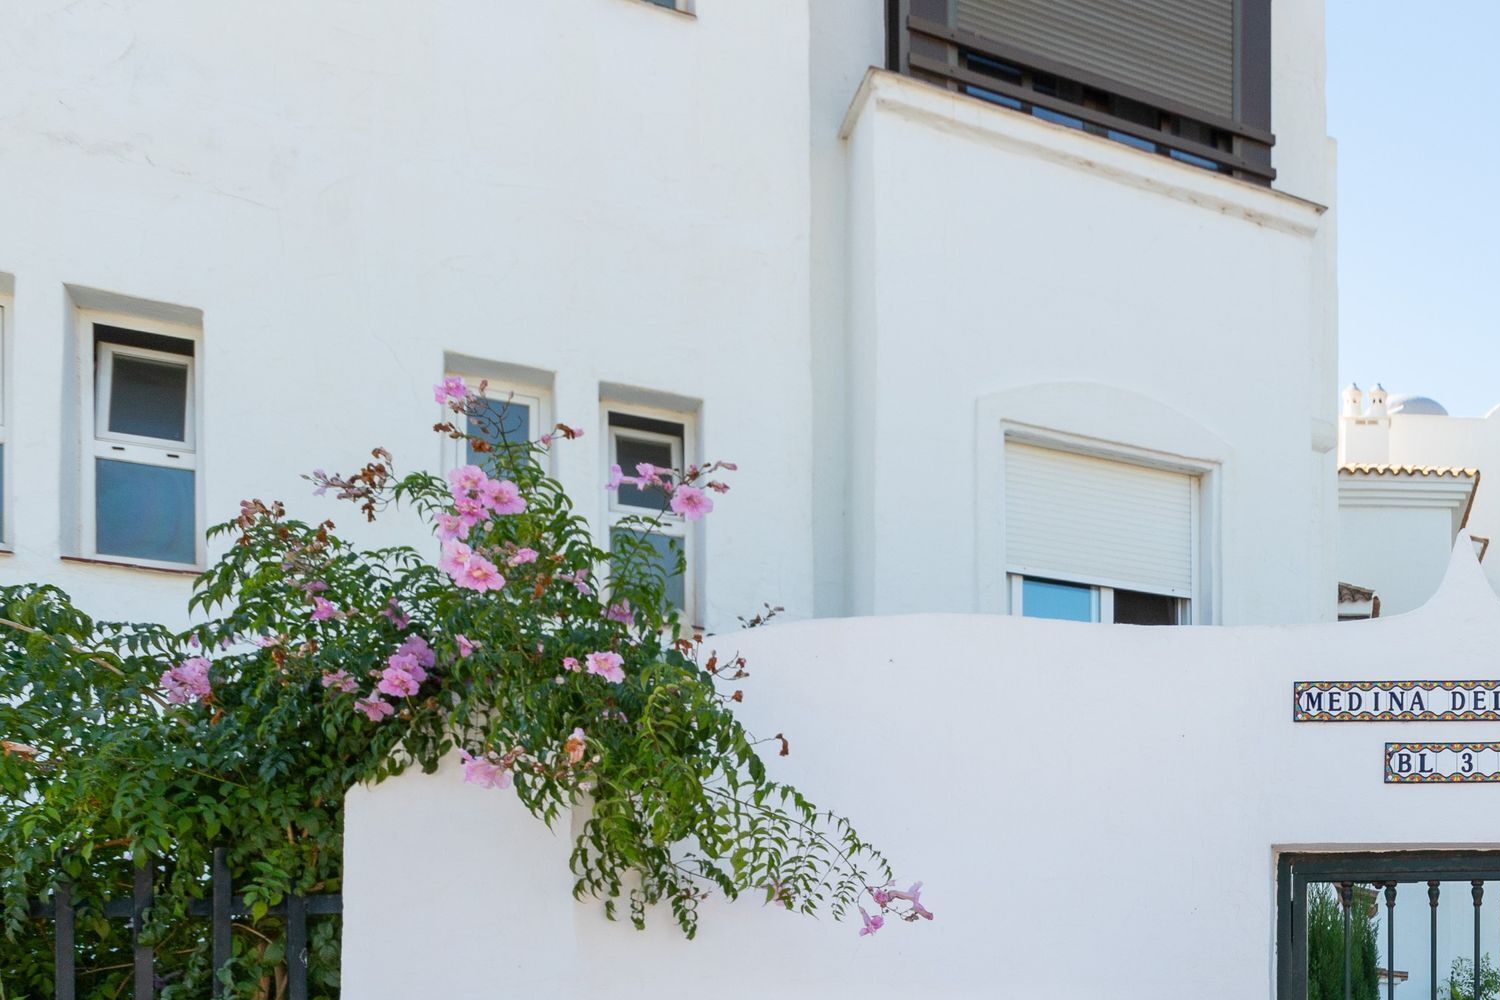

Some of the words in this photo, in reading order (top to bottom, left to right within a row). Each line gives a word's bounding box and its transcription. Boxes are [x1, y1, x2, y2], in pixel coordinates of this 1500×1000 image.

[1305, 690, 1426, 712] MEDINA
[1397, 753, 1434, 774] BL
[1461, 752, 1474, 773] 3
